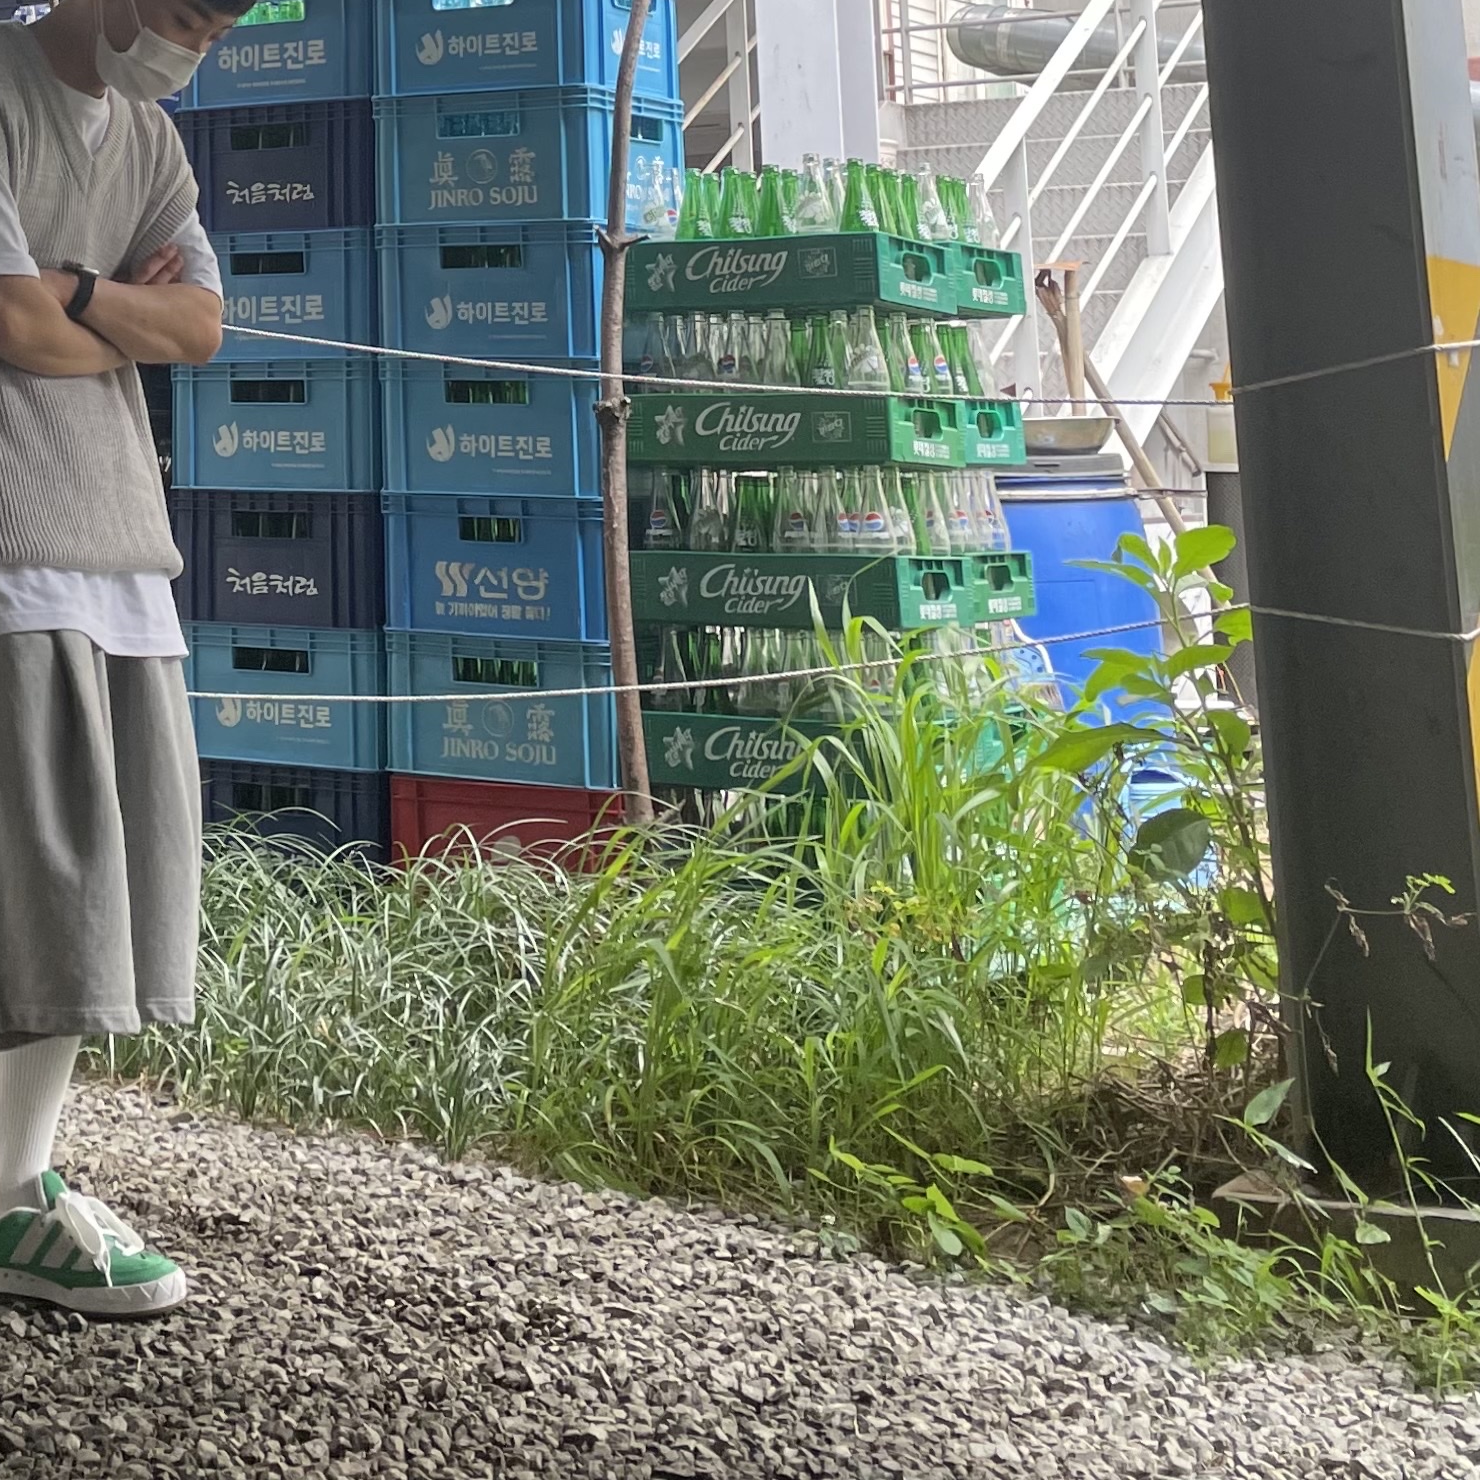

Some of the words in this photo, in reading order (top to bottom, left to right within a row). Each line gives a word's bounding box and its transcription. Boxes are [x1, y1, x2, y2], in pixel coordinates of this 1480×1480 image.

[217, 38, 327, 74] 하이트진로
[447, 30, 538, 58] 하이트진로
[225, 180, 316, 205] 처음처럼
[427, 188, 484, 211] JINRO
[488, 185, 538, 208] SOJU
[685, 245, 788, 288] Chilsung
[709, 274, 768, 294] Cider
[222, 294, 325, 323] 하이트진로
[456, 300, 549, 326] 하이트진로
[694, 401, 802, 449] Chilsung
[241, 429, 327, 455] 하이트진로
[458, 433, 553, 460] 하이트진로
[719, 433, 780, 452] Cider
[225, 567, 319, 597] 처음처럼
[473, 565, 551, 601] 선양
[699, 563, 808, 612] Chilsung
[724, 594, 785, 614] Cider
[246, 700, 332, 729] 하이트진로
[439, 735, 500, 760] JINRO
[504, 741, 557, 766] SOJU
[704, 726, 804, 761] Chilsun
